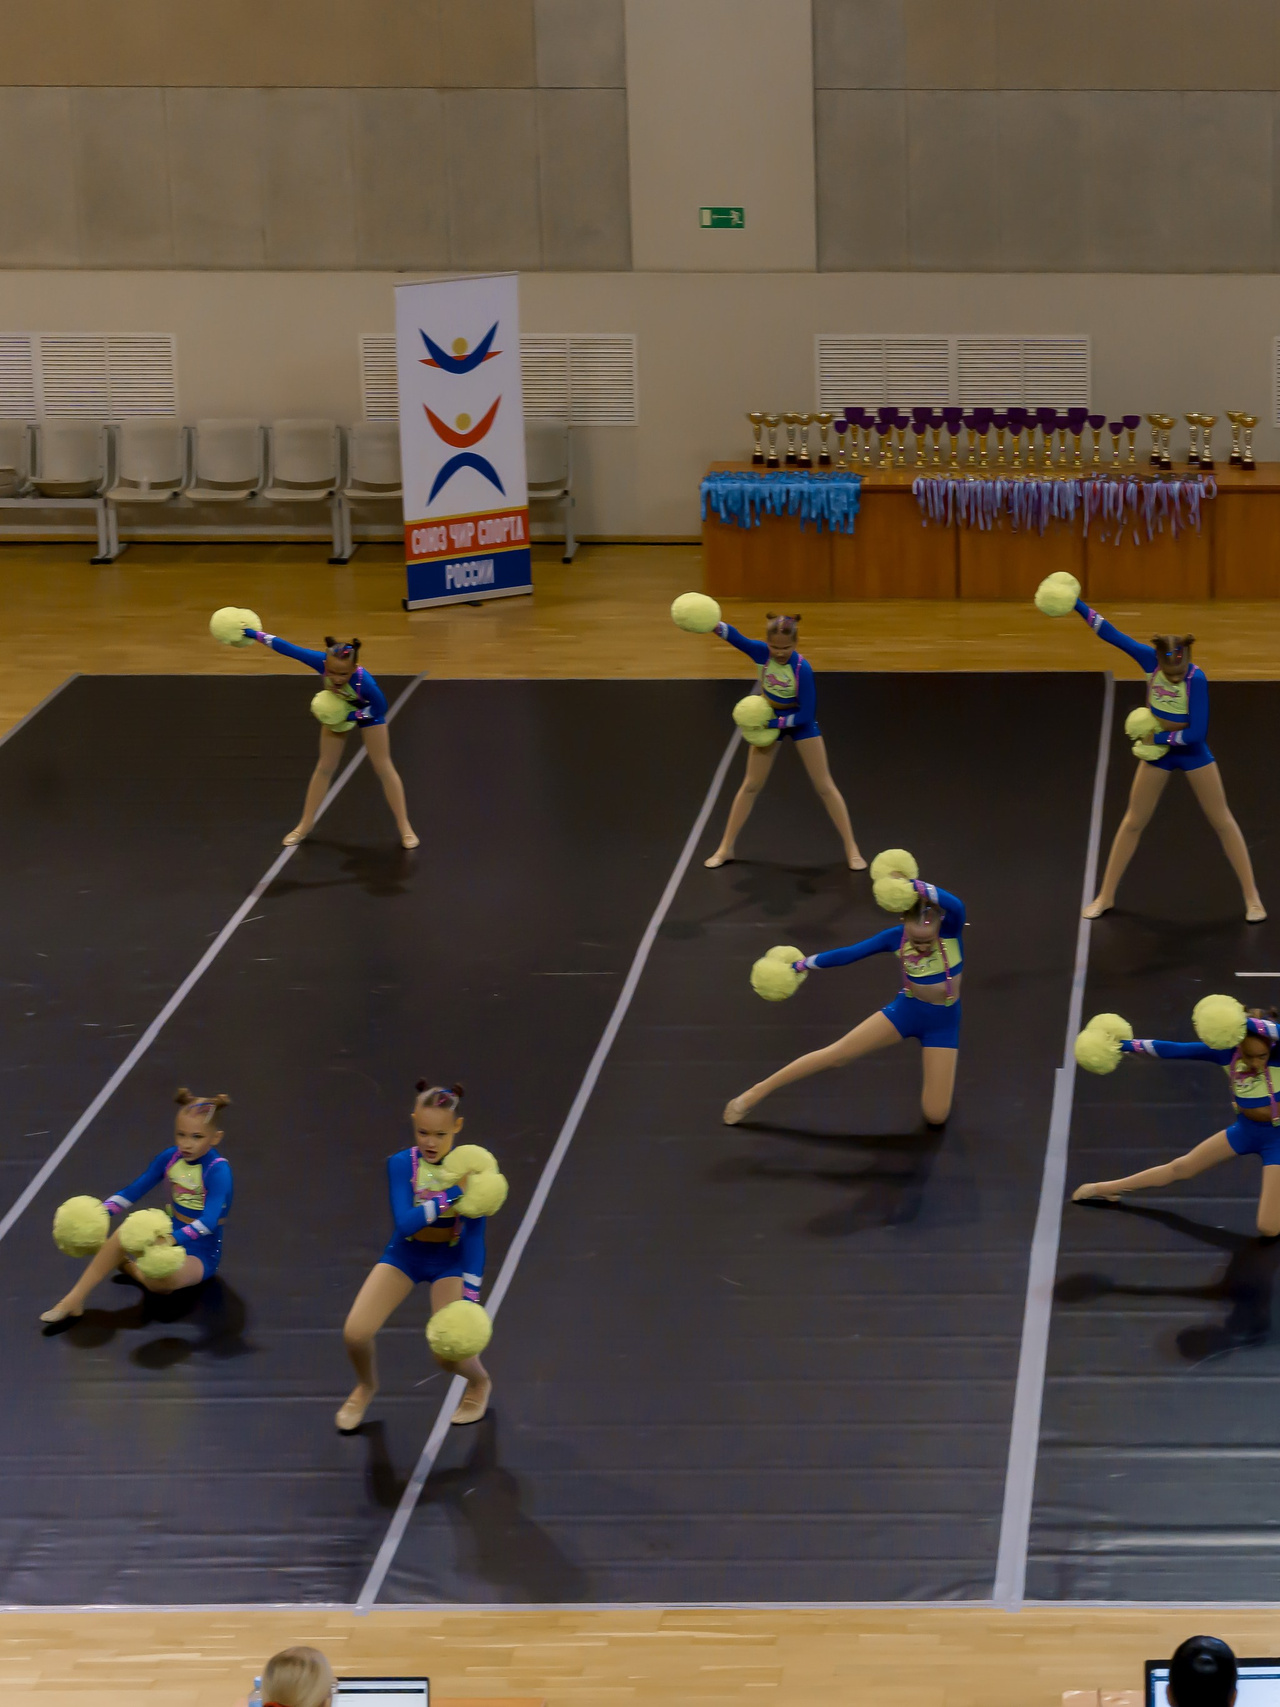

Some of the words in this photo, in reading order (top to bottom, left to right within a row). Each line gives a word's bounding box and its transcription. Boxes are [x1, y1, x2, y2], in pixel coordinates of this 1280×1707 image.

[411, 525, 448, 555] СОЮЗ
[449, 521, 476, 549] ЧИР
[477, 515, 525, 546] СПОРТА
[444, 558, 495, 590] РОССИИ
